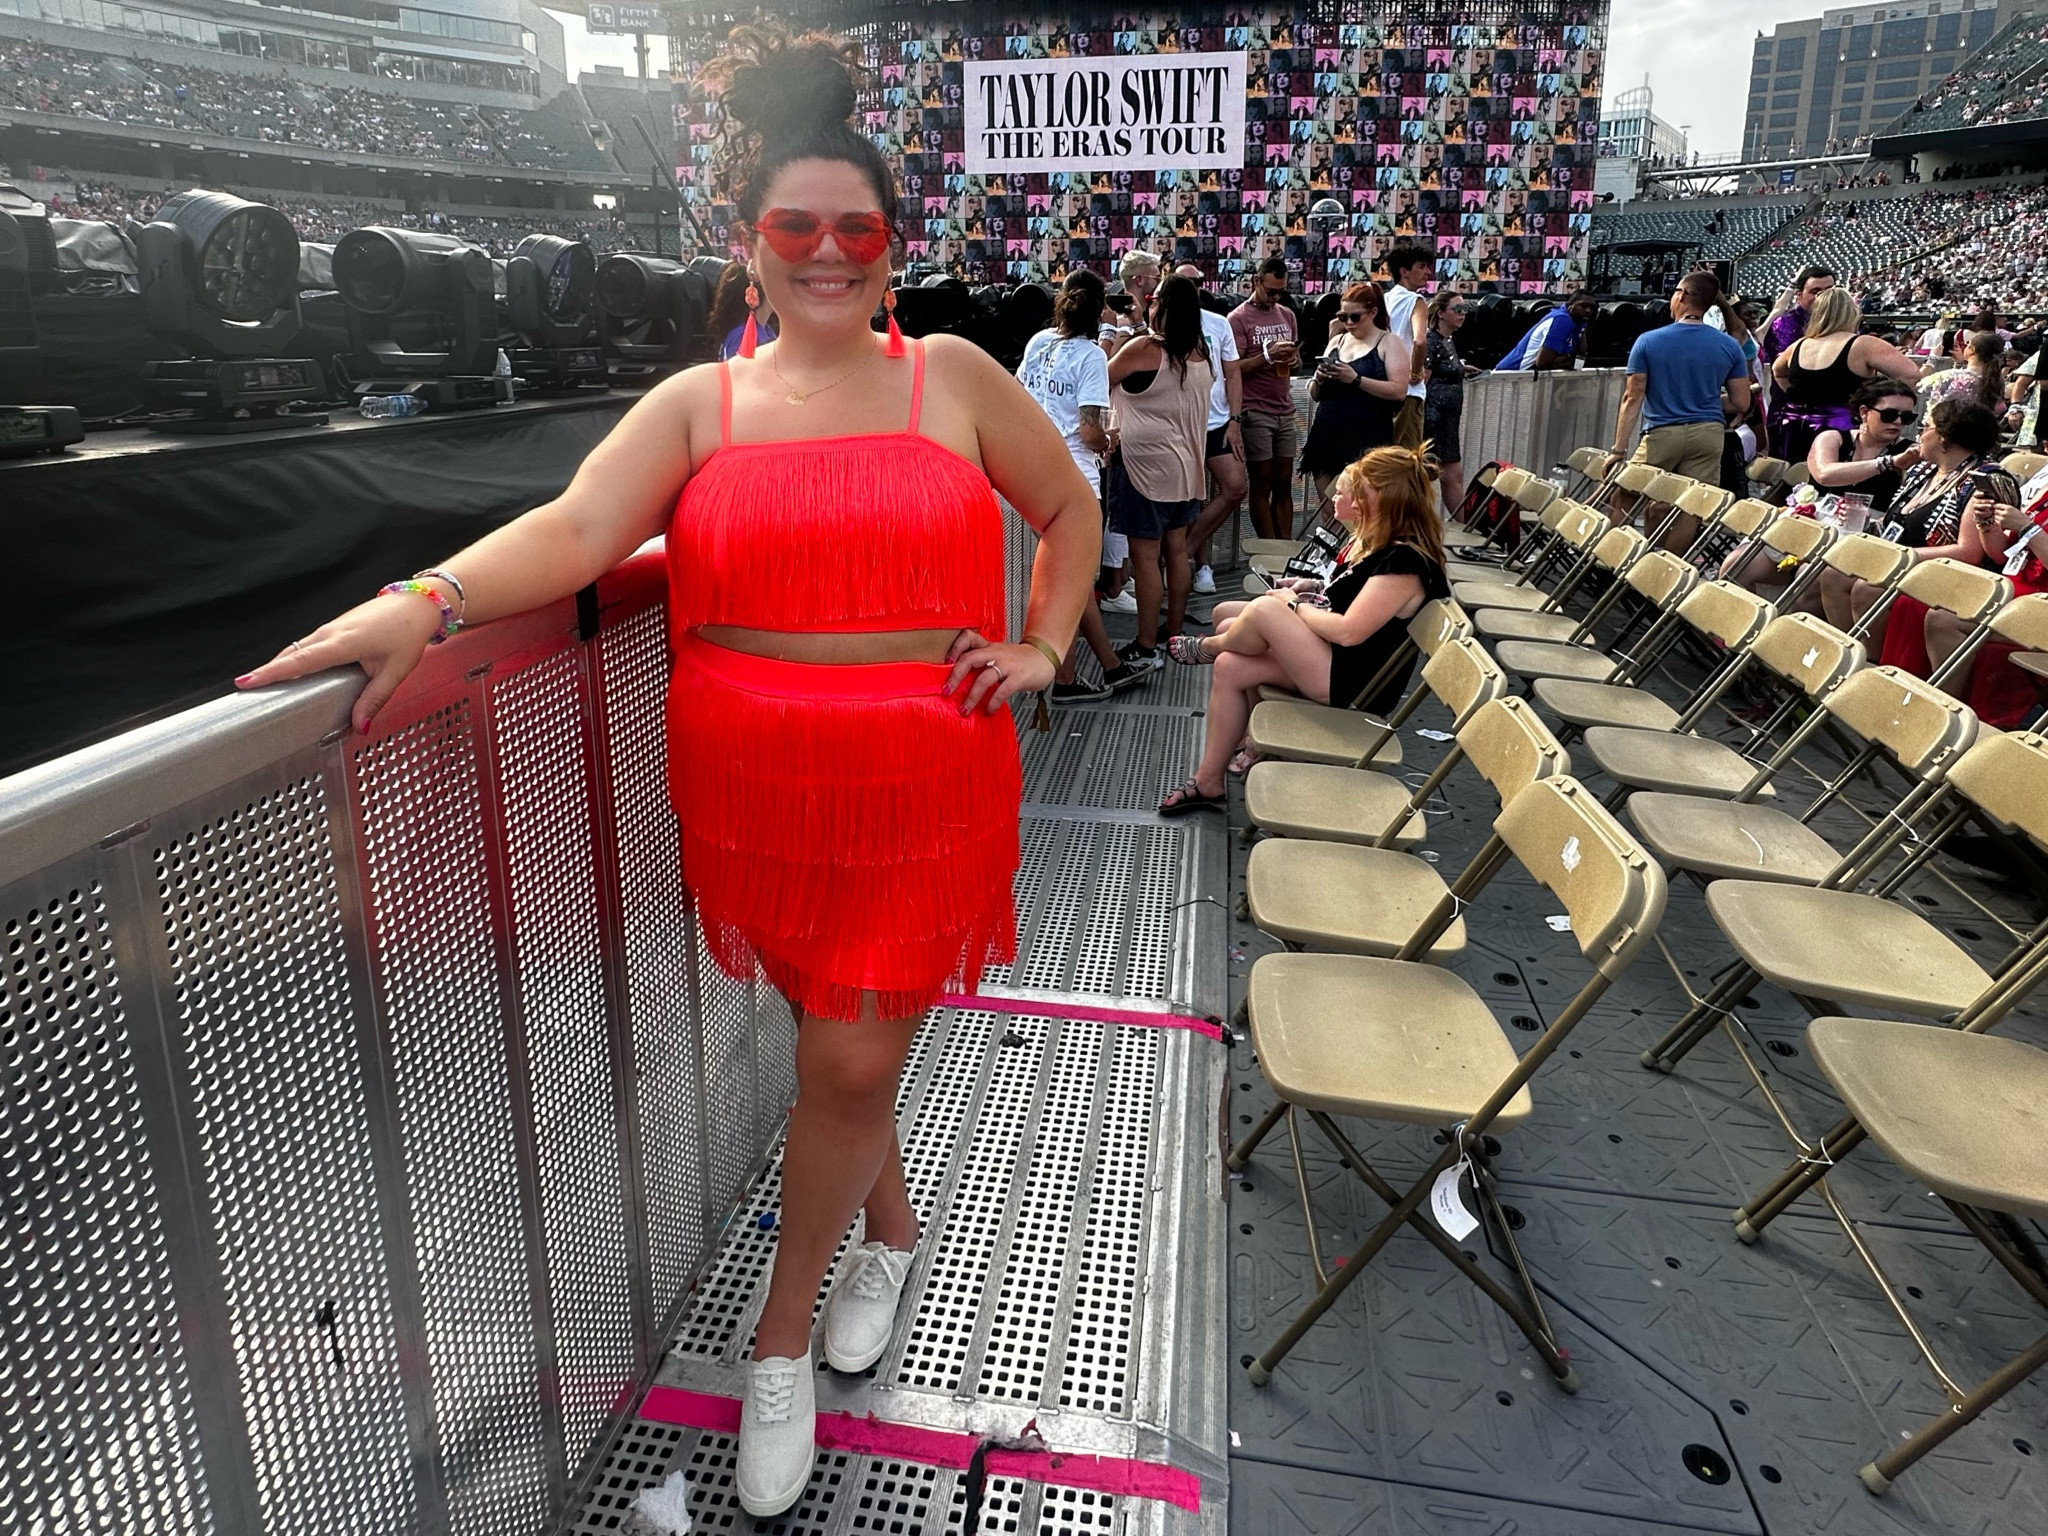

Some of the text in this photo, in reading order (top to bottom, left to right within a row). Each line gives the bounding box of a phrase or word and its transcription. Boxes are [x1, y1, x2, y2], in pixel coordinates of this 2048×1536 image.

[620, 7, 649, 17] FIFTH
[620, 18, 650, 28] BANK
[980, 67, 1229, 129] TAYLOR SWIFT
[981, 126, 1228, 159] THE ERAS TOUR
[1254, 324, 1289, 335] SWIFTIE
[1039, 351, 1056, 368] THE
